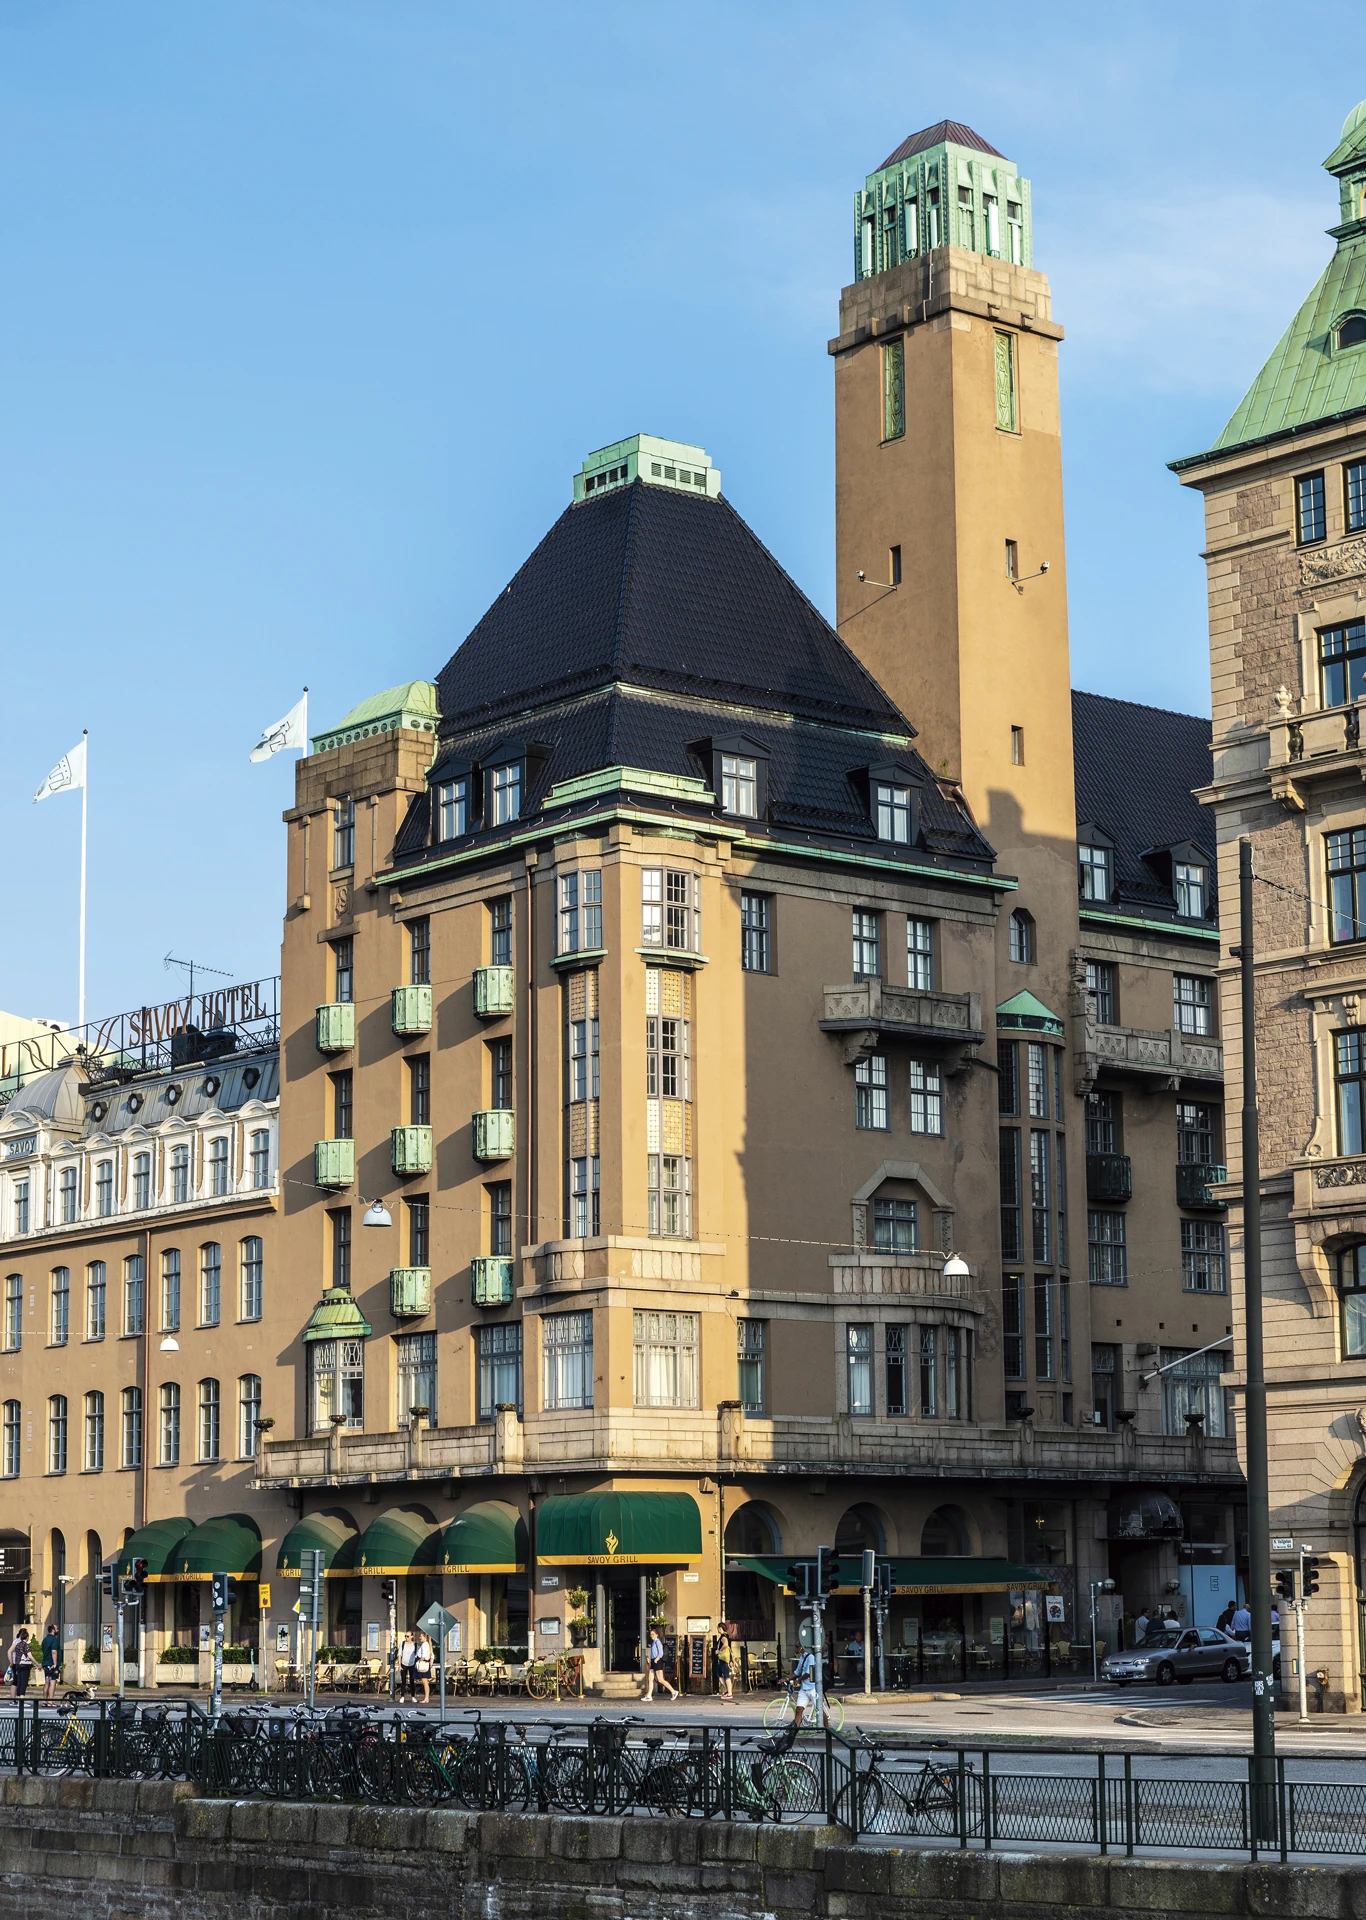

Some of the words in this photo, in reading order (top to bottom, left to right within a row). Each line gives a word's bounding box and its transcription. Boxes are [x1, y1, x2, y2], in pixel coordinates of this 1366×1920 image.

[129, 999, 193, 1047] SAVOY
[201, 982, 268, 1030] HOTEL
[1118, 1529, 1146, 1537] SAVOY
[587, 1556, 611, 1564] SAVOY
[613, 1555, 638, 1563] GRILL
[285, 1569, 301, 1577] GRIL
[363, 1567, 386, 1575] GRILL
[446, 1565, 470, 1573] GRILL
[185, 1572, 204, 1581] GRILL
[901, 1586, 923, 1594] SAVOY
[924, 1585, 945, 1593] GRILL
[1006, 1583, 1027, 1591] SAVOY
[1028, 1582, 1048, 1590] GRILL
